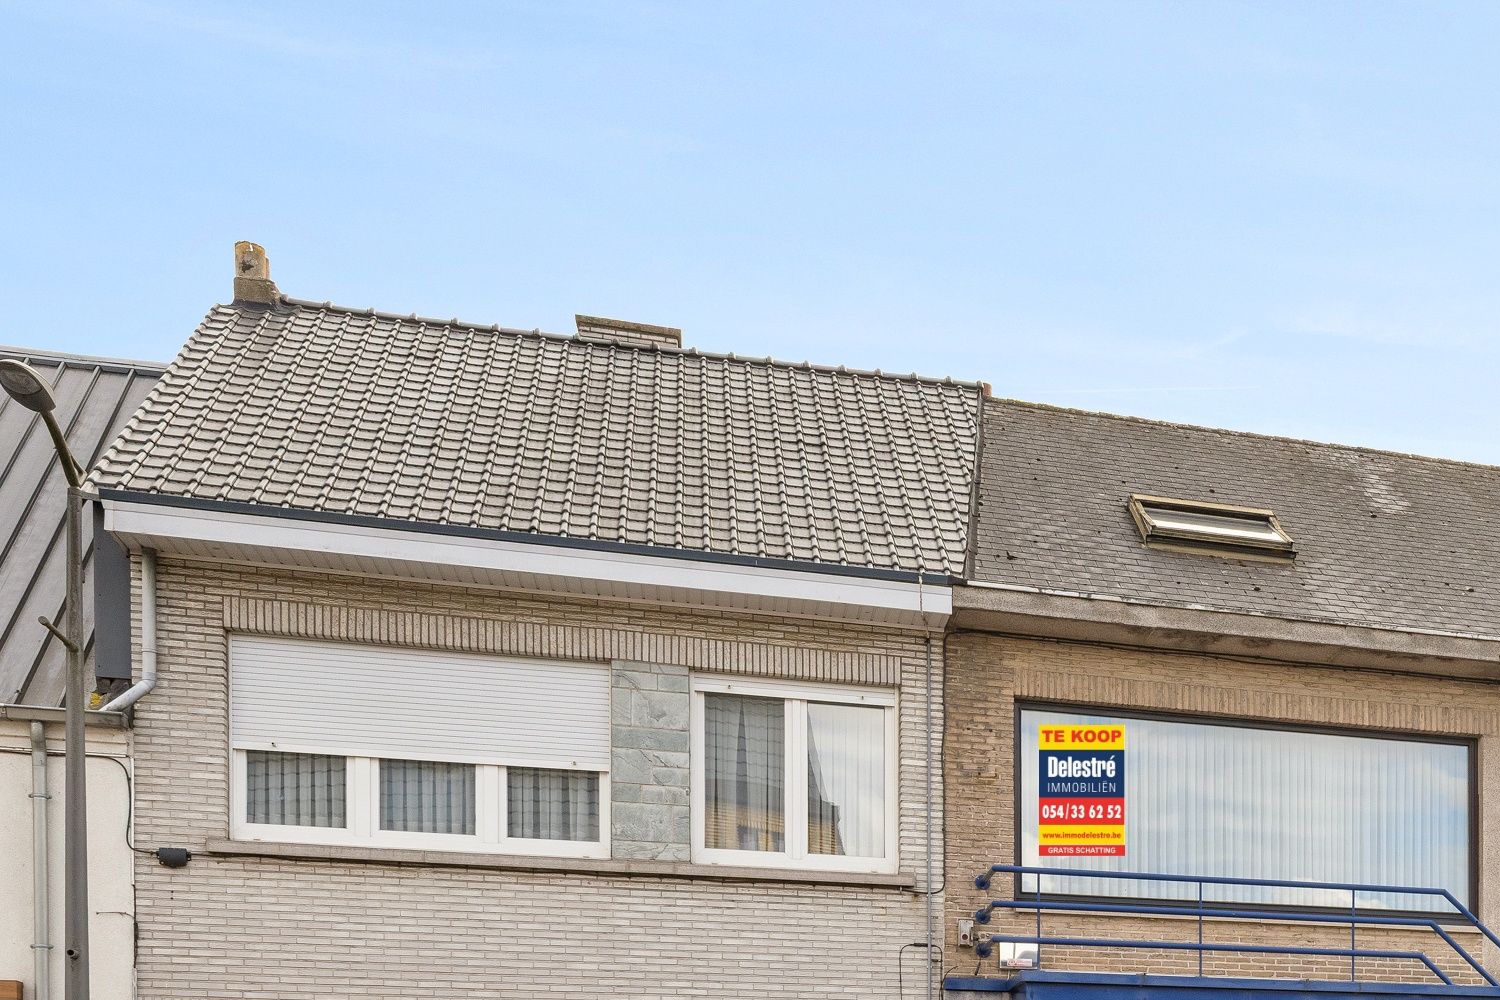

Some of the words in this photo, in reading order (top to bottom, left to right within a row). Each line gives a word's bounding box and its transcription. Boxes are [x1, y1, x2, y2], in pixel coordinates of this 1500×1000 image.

[1042, 730, 1065, 743] TE
[1071, 730, 1122, 743] KOOP
[1047, 755, 1116, 778] Delestré
[1047, 782, 1116, 793] IMMOBILIËN
[1042, 803, 1085, 820] 054/33
[1089, 805, 1104, 819] 62
[1107, 805, 1122, 819] 52
[1042, 832, 1121, 840] www.immodelestre.be
